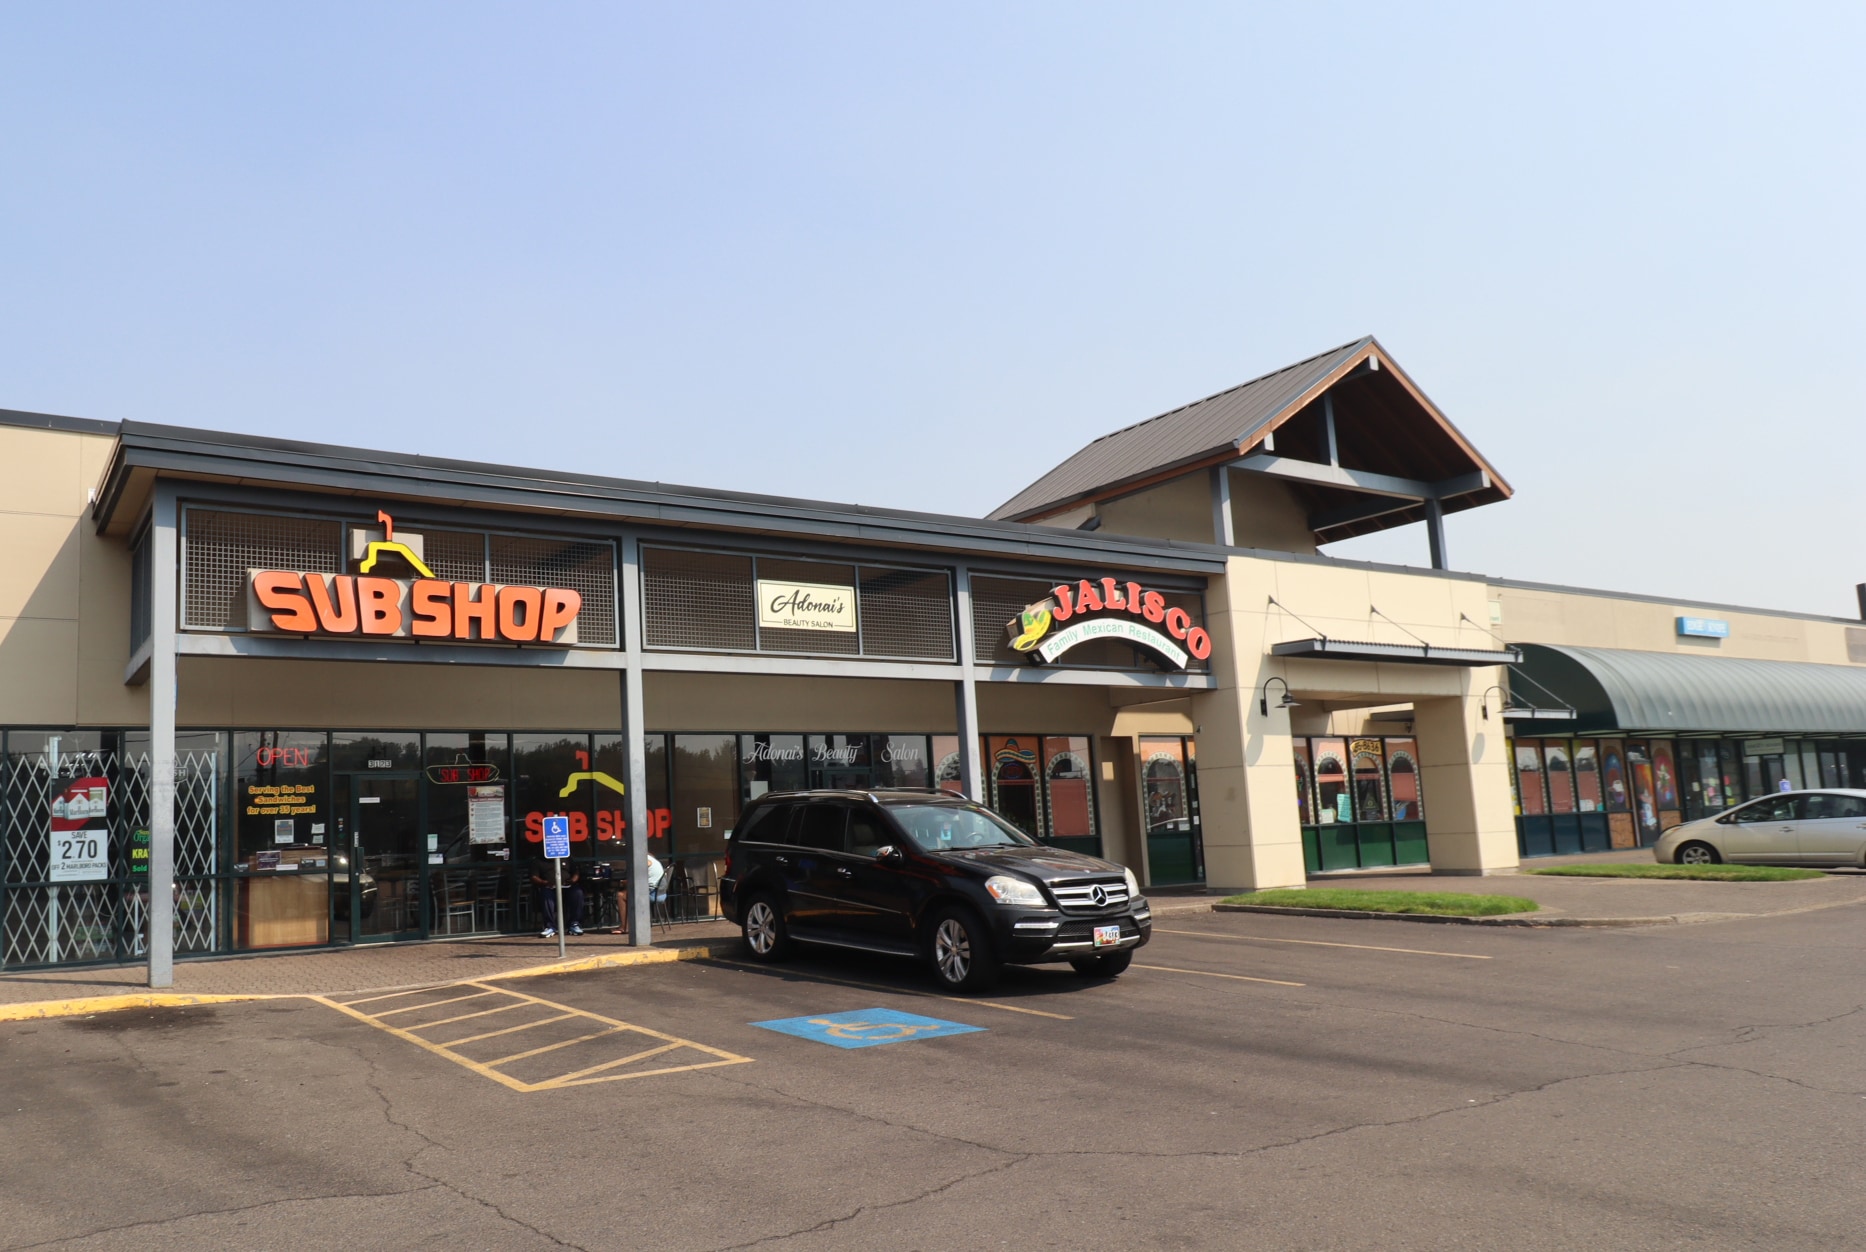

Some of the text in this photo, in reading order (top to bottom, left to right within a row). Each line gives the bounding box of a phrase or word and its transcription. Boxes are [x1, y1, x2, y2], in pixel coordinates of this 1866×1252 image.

[254, 570, 582, 642] SUB SHOP
[770, 589, 845, 616] Adonai's
[783, 619, 809, 627] BEAUTY
[1053, 577, 1212, 660] JALISCO
[1047, 621, 1182, 661] Family Mexican Restaurant
[257, 747, 309, 766] OPEN
[742, 741, 919, 764] Adonai's Beauty Salon
[368, 760, 392, 768] 3123
[440, 767, 491, 782] SUB SHOP
[248, 784, 315, 795] Serving the Best
[256, 795, 306, 804] Sandwiches
[247, 806, 260, 815] for
[279, 805, 290, 814] 35
[290, 805, 316, 815] years!
[524, 811, 589, 842] SB
[71, 831, 87, 839] SAVE
[132, 849, 150, 859] KRA
